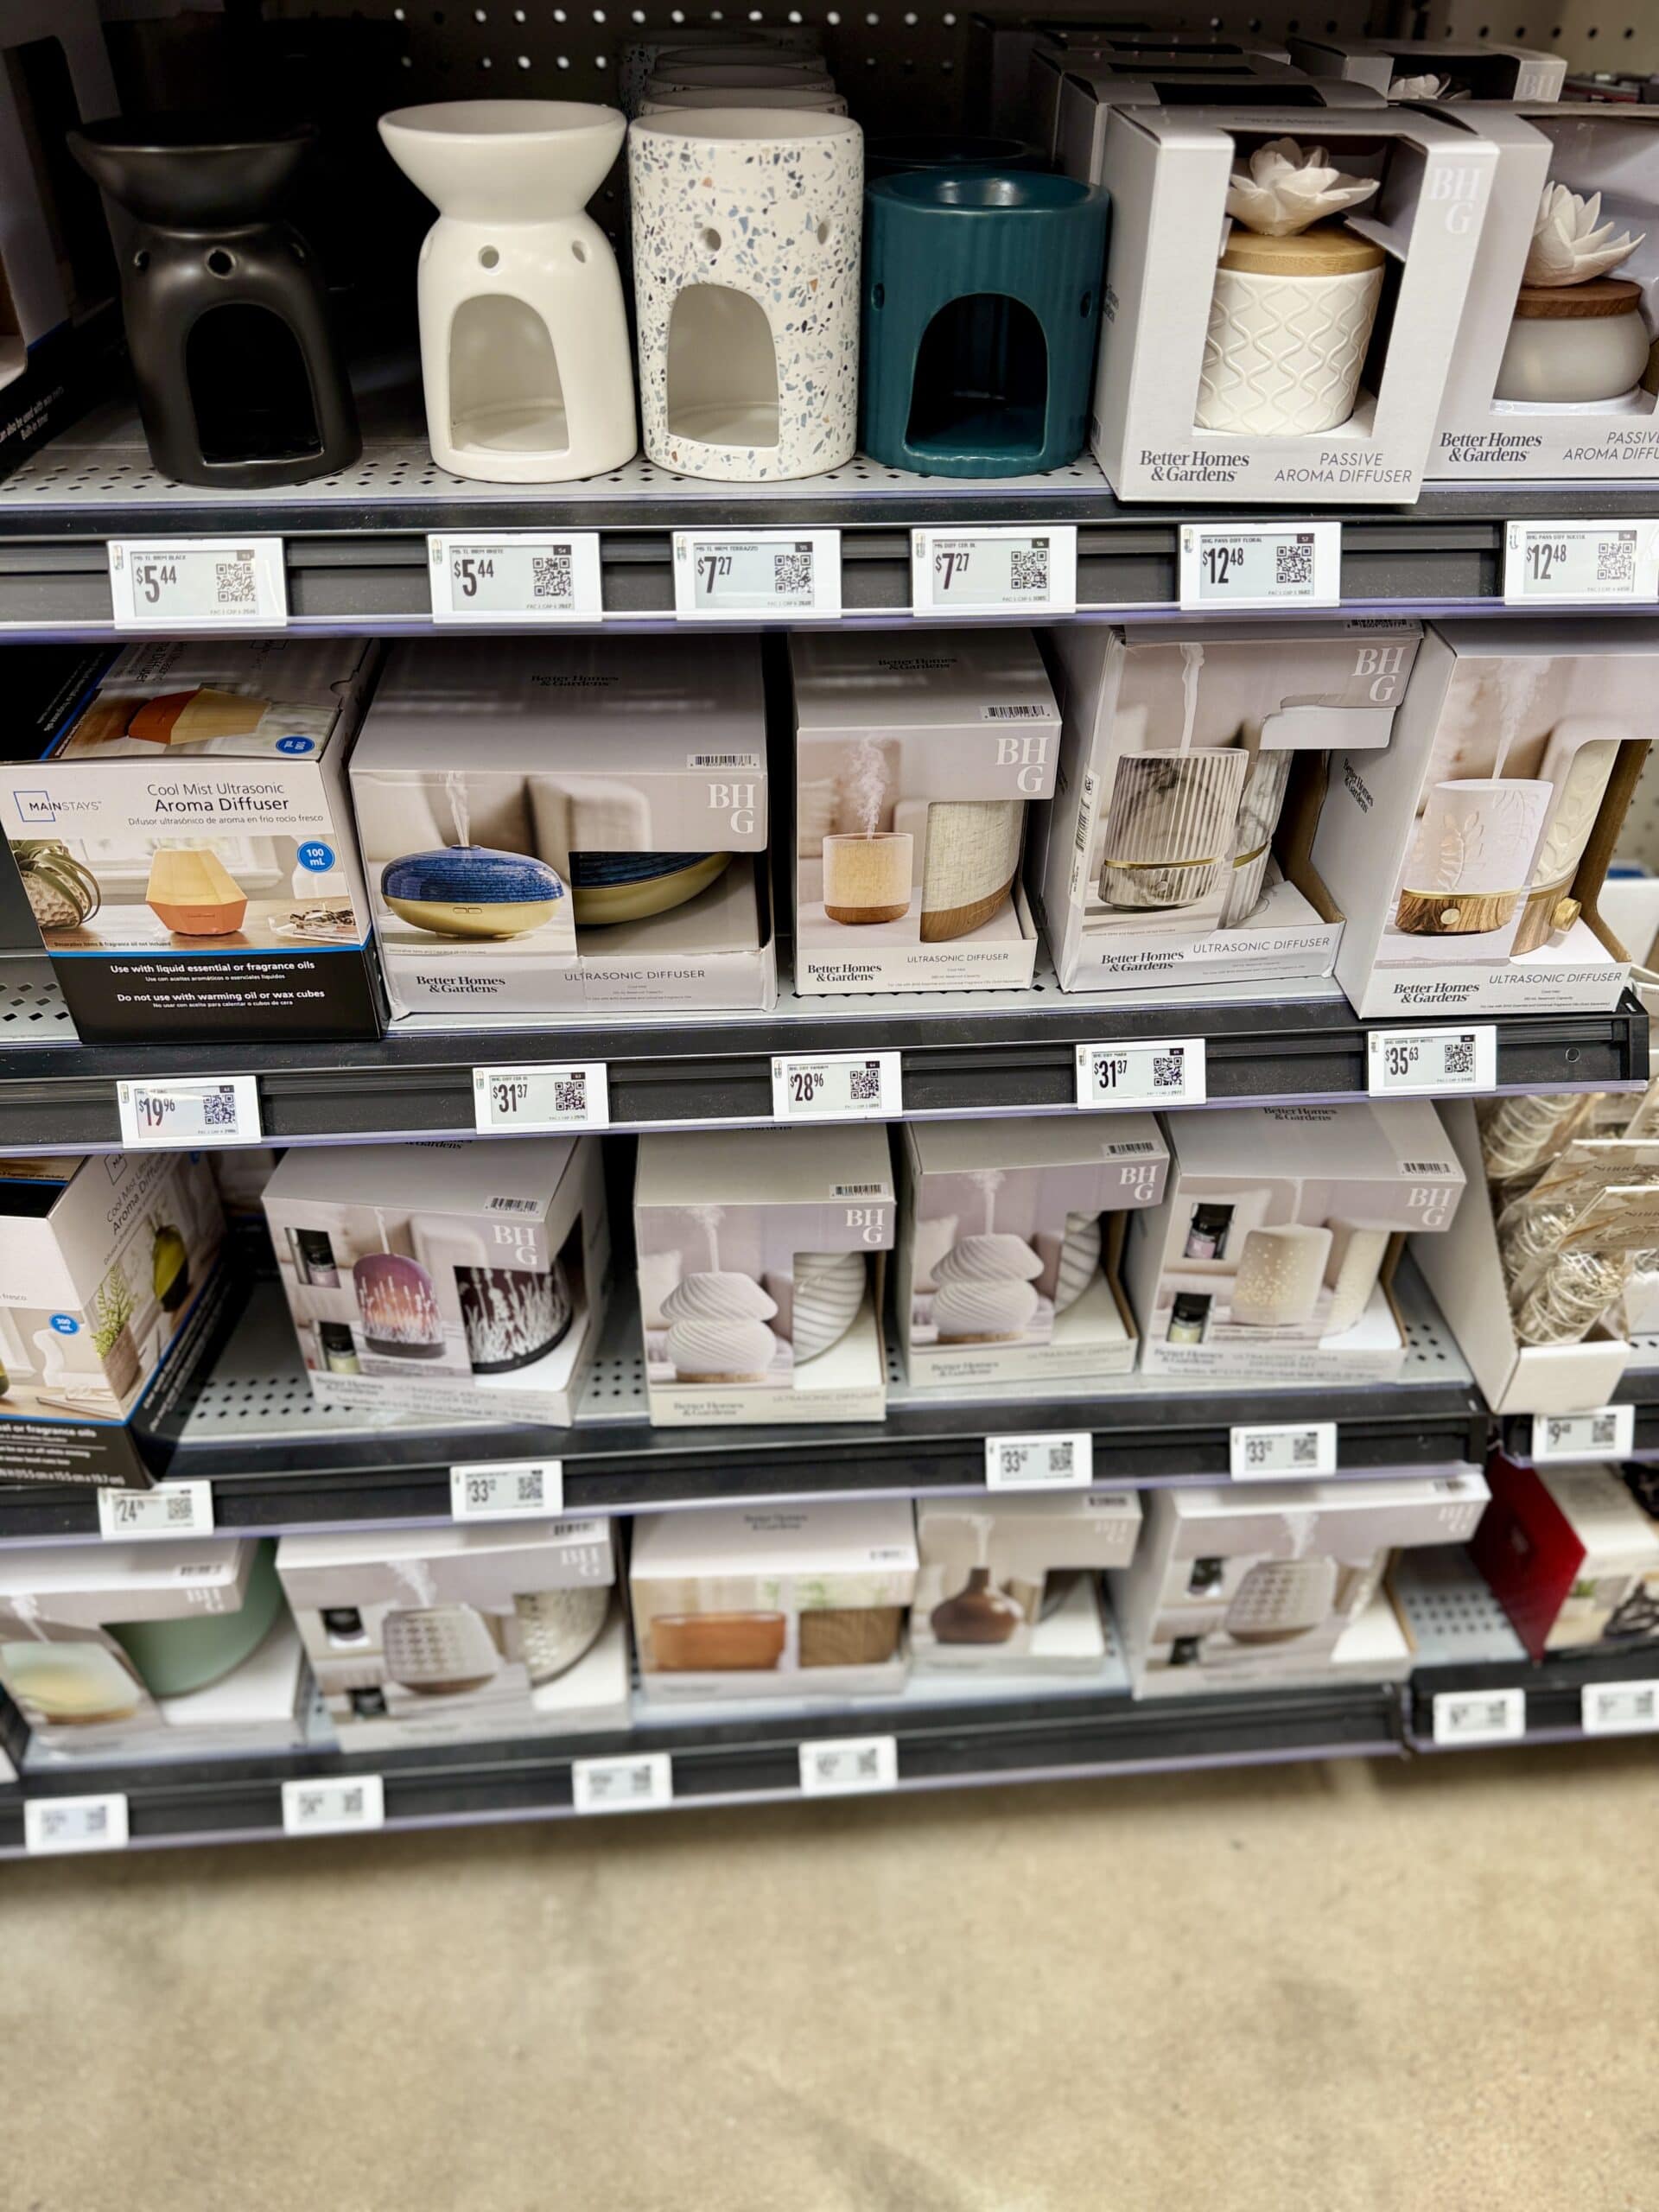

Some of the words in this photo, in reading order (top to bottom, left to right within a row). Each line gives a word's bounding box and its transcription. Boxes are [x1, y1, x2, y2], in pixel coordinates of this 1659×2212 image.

[1440, 432, 1487, 447] Better
[1487, 432, 1542, 447] Homes
[1140, 450, 1190, 466] Better
[1192, 451, 1249, 467] Homes
[1319, 453, 1383, 467] PASSIVE
[1562, 448, 1618, 461] AROMA
[1274, 469, 1335, 483] AROMA
[1339, 469, 1413, 483] DIFFUSER
[1351, 647, 1408, 677] BH
[1370, 675, 1396, 702] G
[995, 736, 1051, 766] BH
[1016, 766, 1044, 793] G
[147, 783, 180, 796] Cool
[183, 783, 213, 796] Mist
[216, 782, 285, 795] Ultrasonic
[707, 784, 756, 809] BH
[155, 798, 214, 812] Aroma
[219, 797, 289, 811] Diffuser
[128, 817, 157, 826] Difusor
[299, 814, 324, 823] fresco
[730, 809, 754, 834] G
[306, 848, 324, 859] 100
[309, 857, 326, 867] mL
[1193, 941, 1270, 954] ULTRASONIC
[1274, 937, 1330, 950] DIFFUSER
[907, 954, 963, 963] ULTRASONIC
[967, 953, 1009, 962] DIFFUSER
[1101, 954, 1140, 965] Better
[1139, 951, 1184, 963] Homes
[110, 965, 130, 974] Use
[130, 964, 155, 974] with
[156, 963, 186, 975] liquid
[187, 963, 232, 973] essential
[246, 962, 296, 973] fragrance
[297, 960, 315, 969] oils
[808, 964, 841, 974] Better
[842, 963, 882, 973] Homes
[416, 976, 456, 985] Better
[458, 976, 505, 985] Homes
[564, 971, 644, 982] ULTRASONIC
[647, 969, 706, 979] DIFFUSER
[1489, 974, 1564, 984] ULTRASONIC
[1567, 972, 1622, 982] DIFFUSER
[1393, 983, 1433, 994] Better
[1433, 982, 1479, 993] Homes
[117, 994, 133, 1003] Do
[134, 994, 152, 1002] not
[172, 992, 196, 1001] with
[197, 991, 243, 1002] warming
[245, 991, 257, 1000] oil
[296, 989, 325, 998] cubes
[1120, 1165, 1159, 1185] BH
[1134, 1183, 1154, 1201] G
[1407, 1188, 1453, 1207] BH
[846, 1209, 885, 1226] BH
[1421, 1207, 1445, 1225] G
[493, 1224, 535, 1247] BH
[863, 1226, 883, 1243] G
[515, 1247, 538, 1266] G
